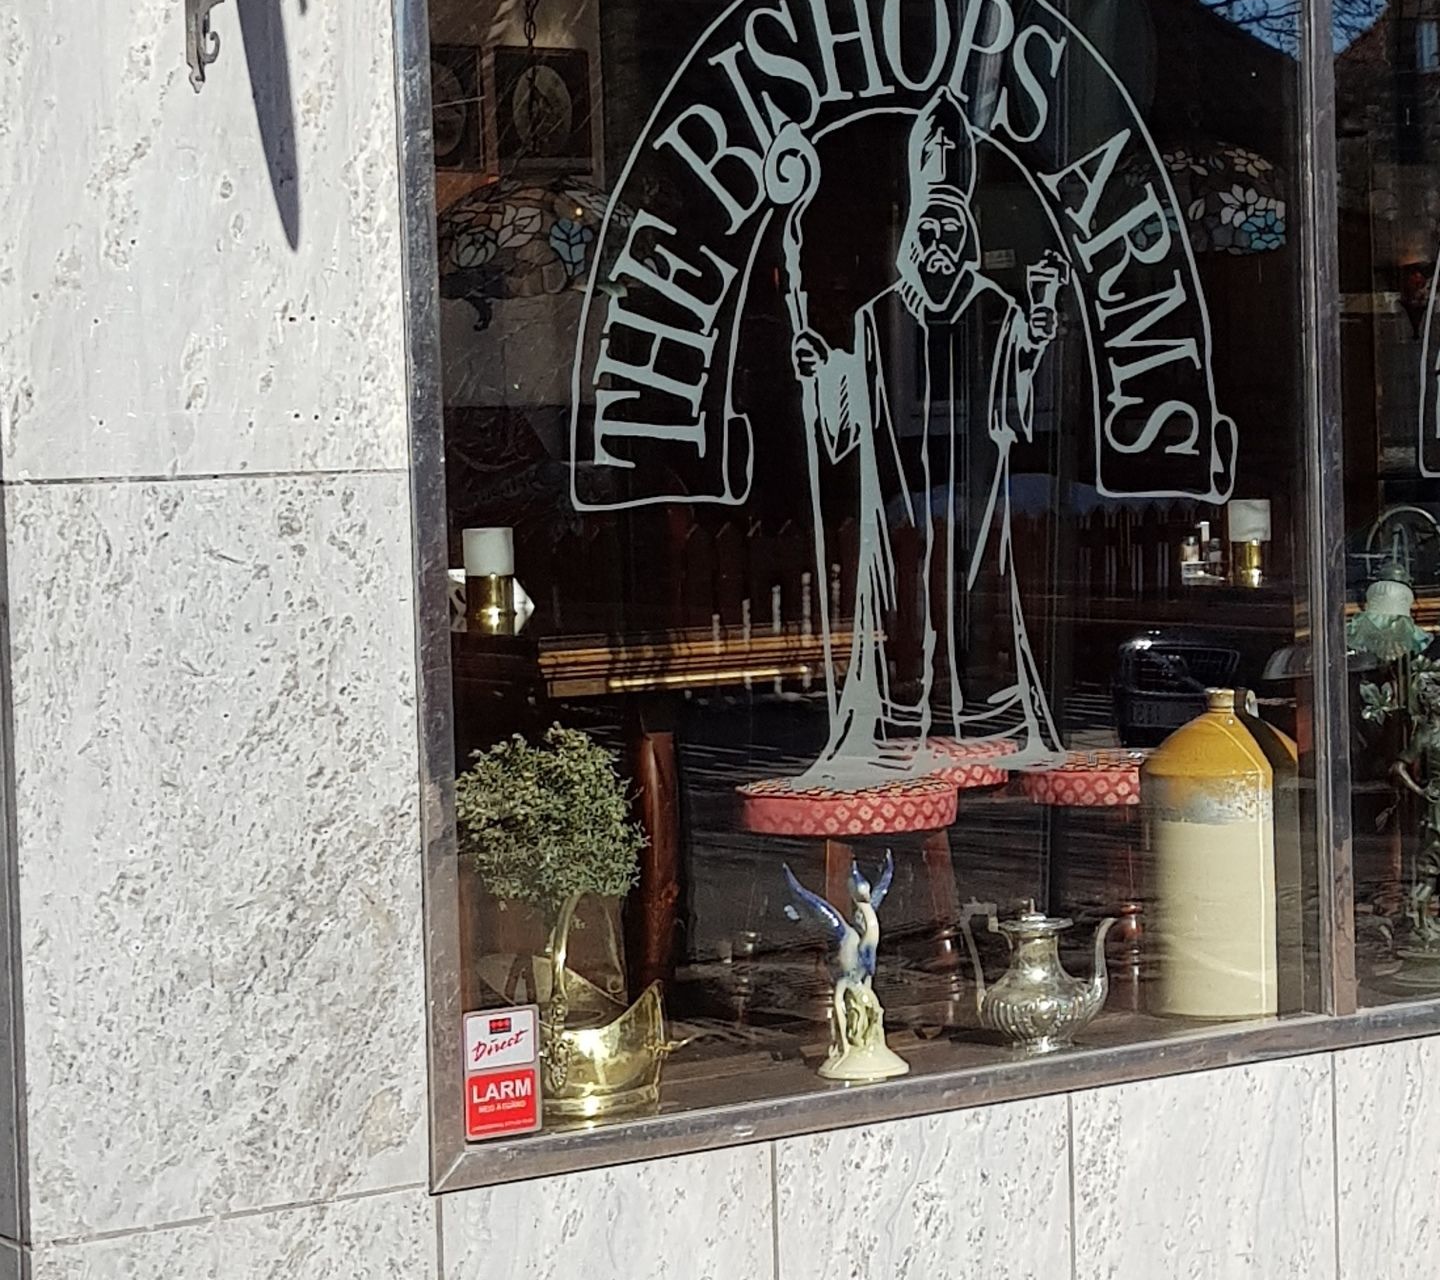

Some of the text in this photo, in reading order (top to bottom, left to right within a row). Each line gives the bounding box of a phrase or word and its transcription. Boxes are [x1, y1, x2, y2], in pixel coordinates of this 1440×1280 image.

[593, 208, 739, 468] THE
[1037, 127, 1202, 456] ARMS
[472, 1077, 531, 1104] LARM
